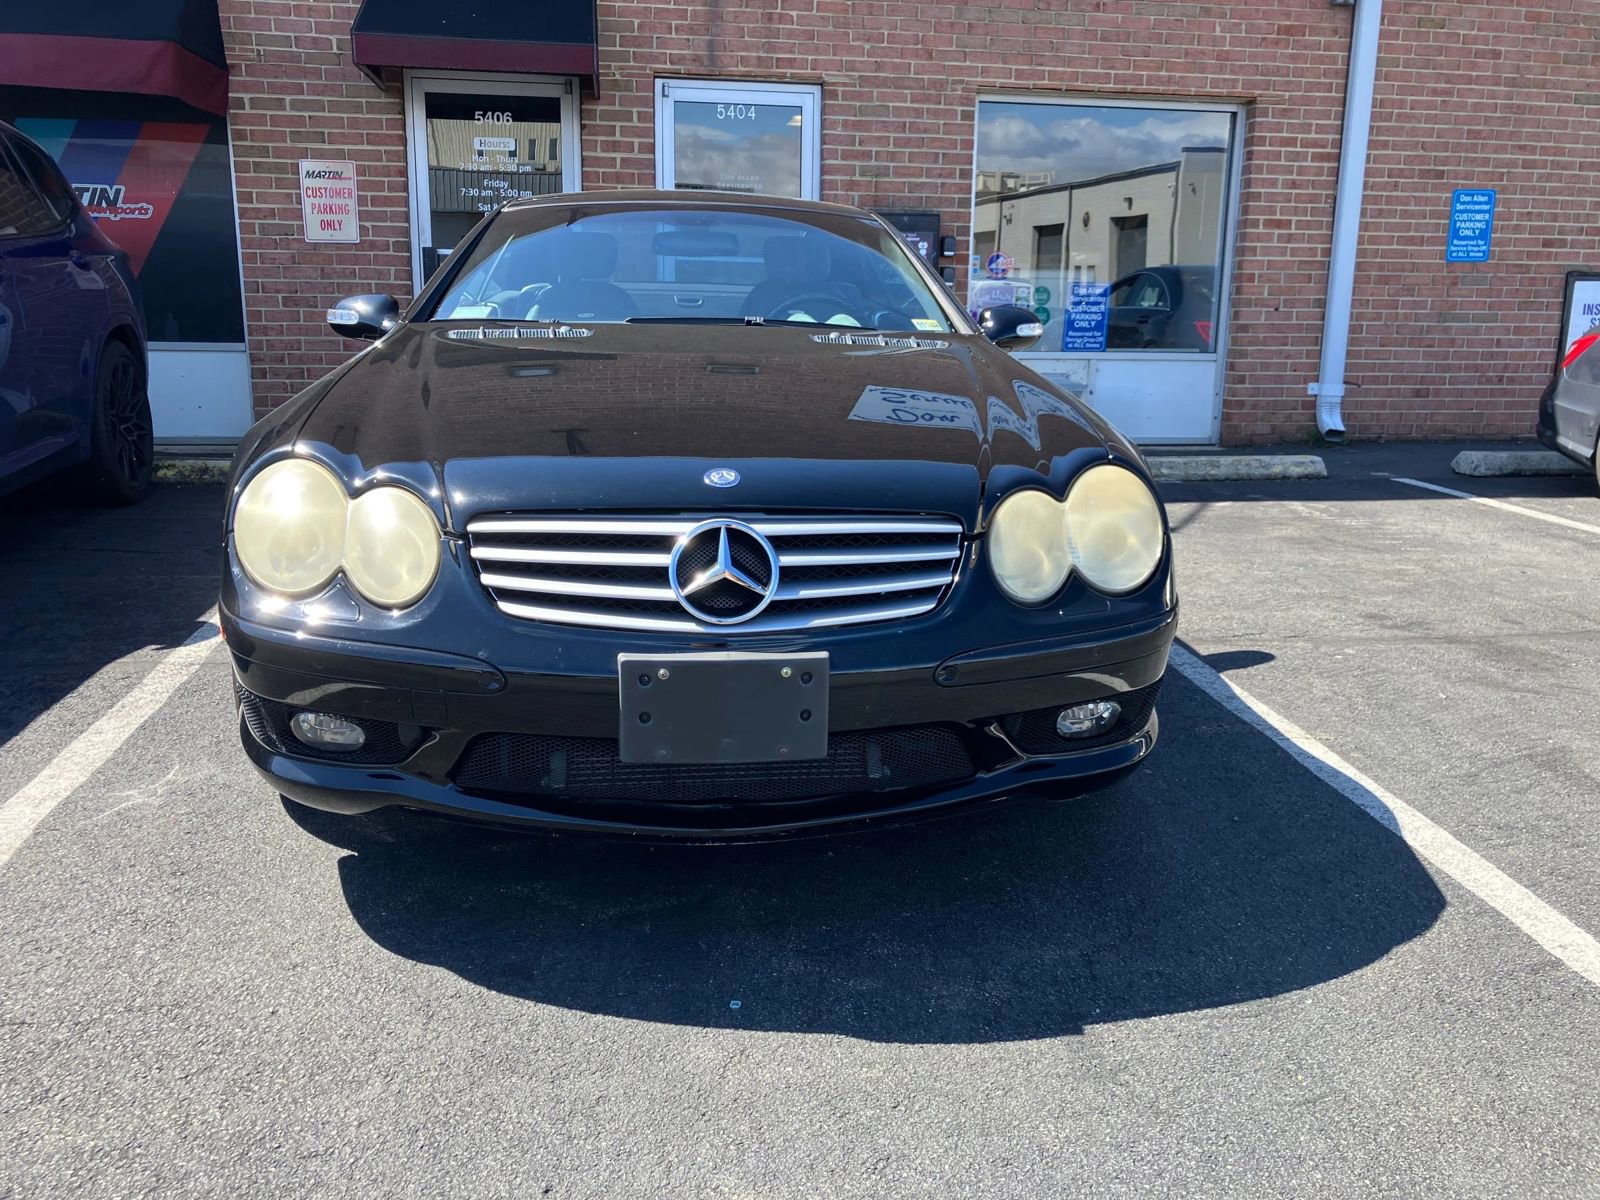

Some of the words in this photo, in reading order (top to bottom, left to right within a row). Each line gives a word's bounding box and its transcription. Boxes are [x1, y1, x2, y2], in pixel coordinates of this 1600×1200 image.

[716, 104, 756, 120] 5404
[474, 111, 513, 126] 5406
[479, 138, 511, 149] Hours:
[471, 155, 489, 163] Mon
[496, 155, 518, 163] Thurs
[459, 163, 478, 171] 7:30
[498, 163, 518, 172] 5:30
[518, 164, 532, 173] pm
[304, 170, 344, 179] MARTIN
[483, 179, 509, 189] Friday
[305, 186, 353, 199] CUSTOMER
[460, 188, 480, 197] 7:30
[500, 189, 518, 198] 5:00
[1460, 194, 1472, 202] Don
[1473, 194, 1488, 202] Allen
[311, 202, 350, 215] PARKING
[478, 203, 491, 211] Sat
[1455, 203, 1491, 211] Servicenter
[320, 219, 343, 231] ONLY
[1456, 221, 1486, 229] PARKING
[1459, 229, 1480, 237] ONLY
[1073, 286, 1086, 294] Don
[1070, 313, 1103, 321] PARKING
[1073, 320, 1097, 328] ONLY
